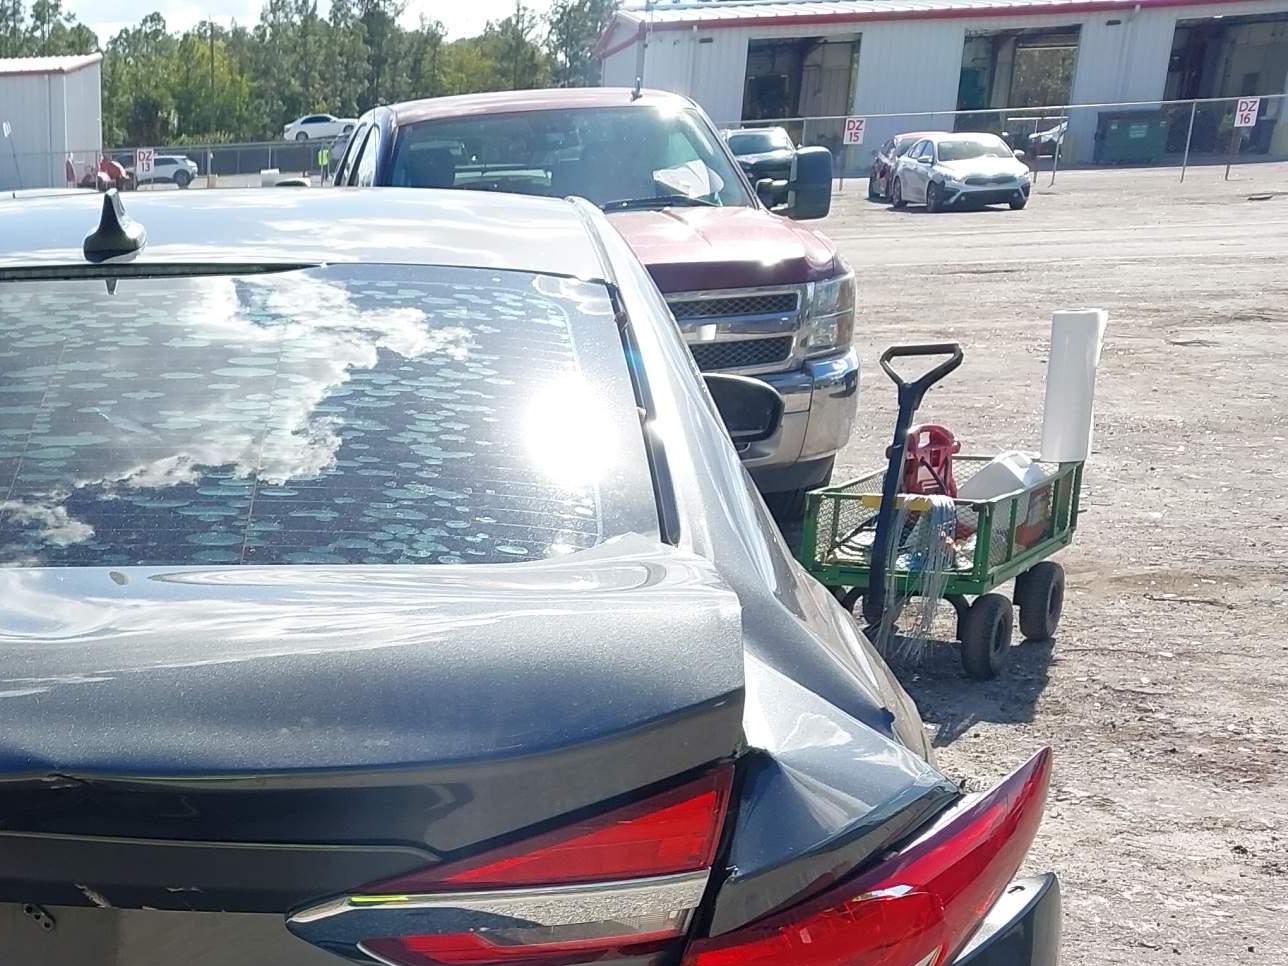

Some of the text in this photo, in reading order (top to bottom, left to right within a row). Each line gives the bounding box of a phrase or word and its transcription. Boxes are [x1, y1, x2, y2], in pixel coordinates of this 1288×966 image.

[1239, 101, 1257, 112] DZ
[1240, 113, 1251, 124] 16
[847, 120, 864, 130] DZ
[849, 132, 860, 142] 15
[138, 151, 152, 161] DZ
